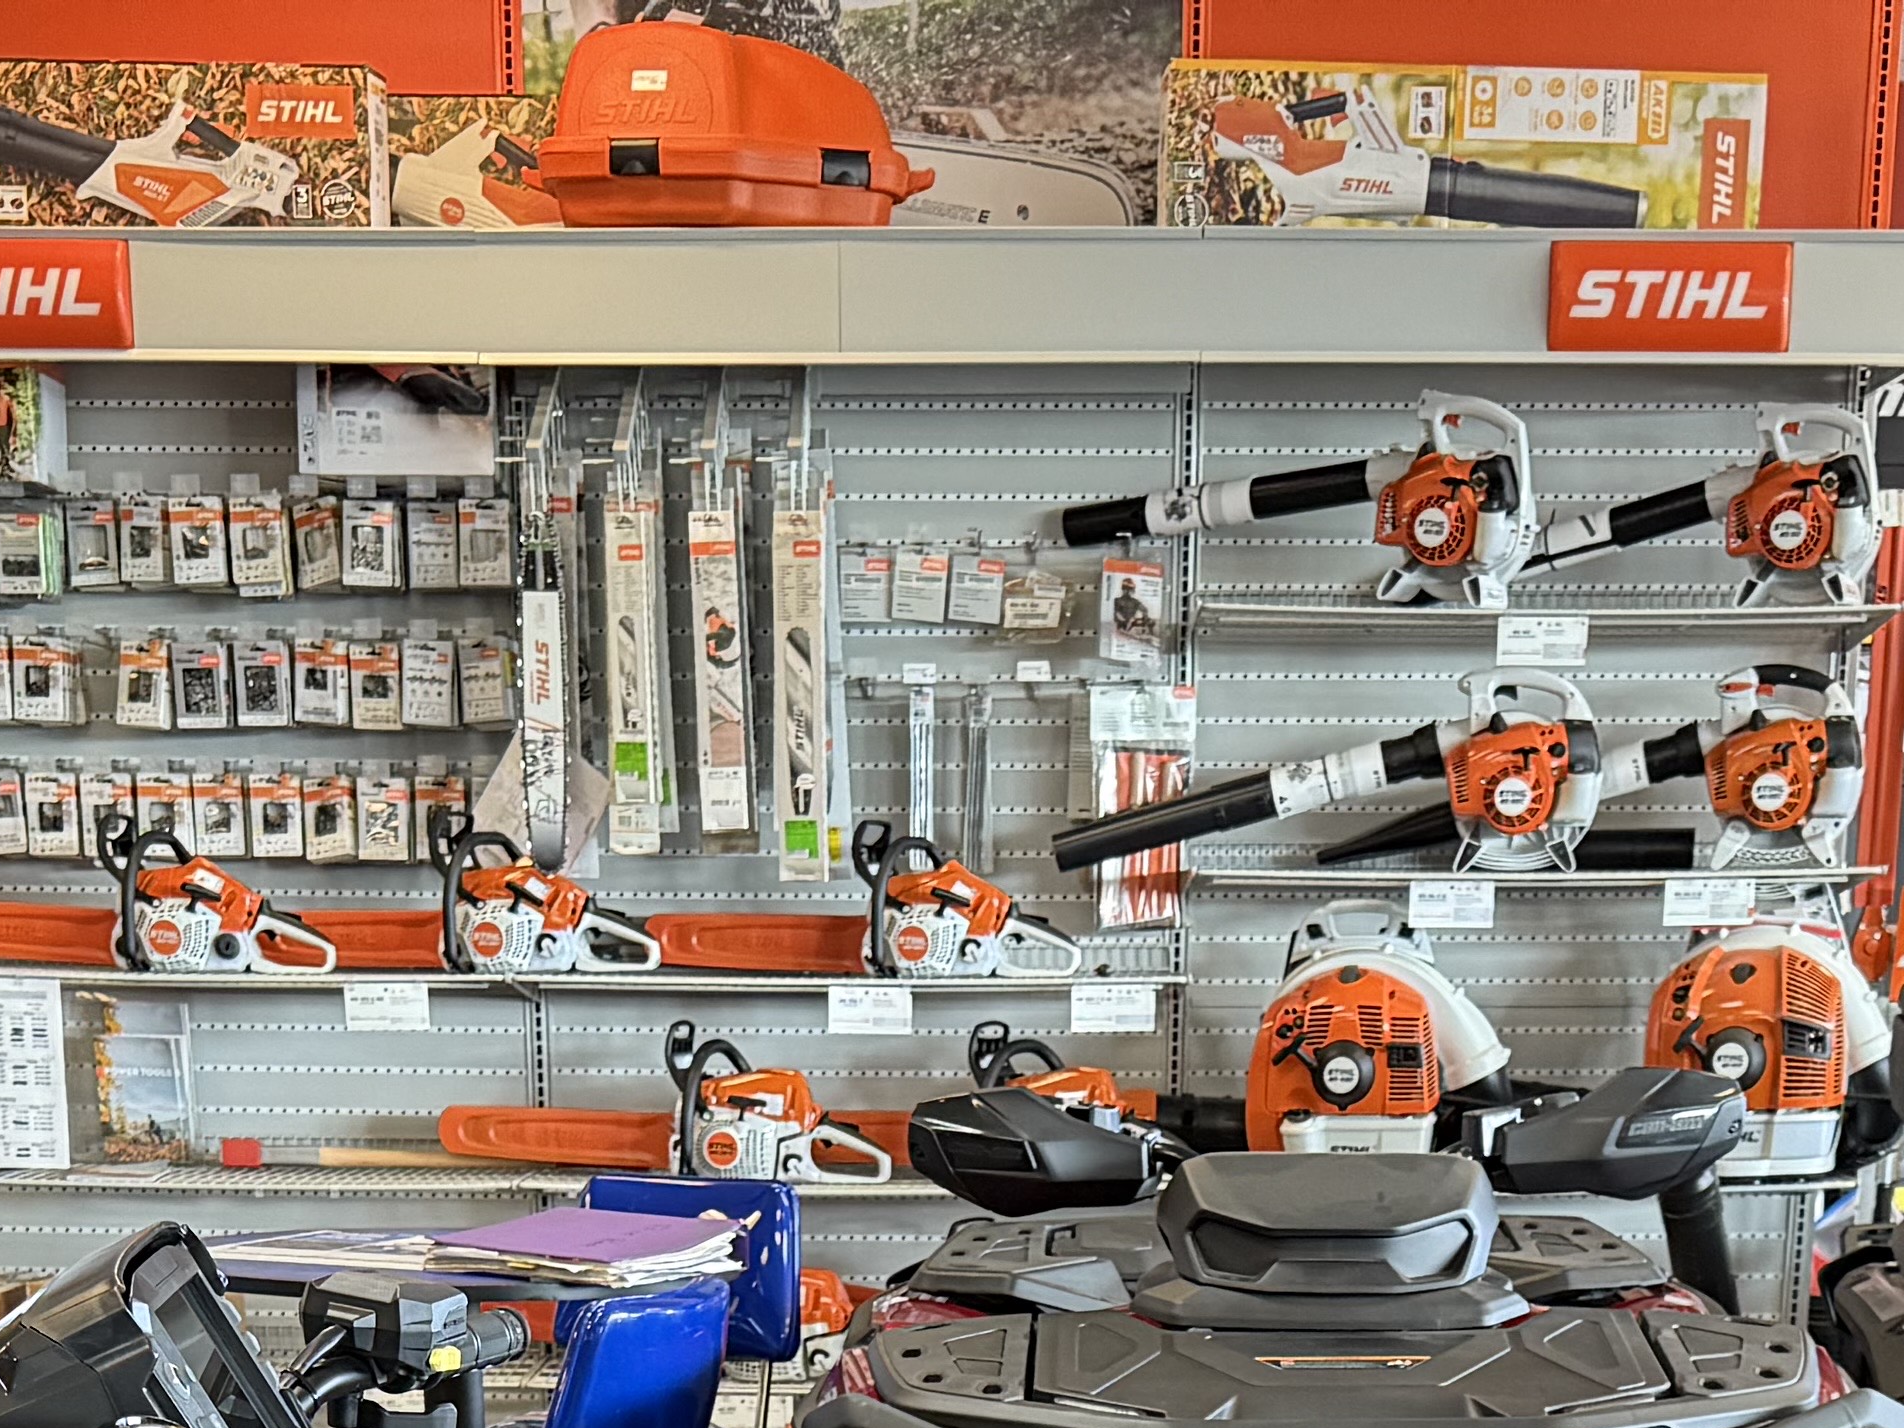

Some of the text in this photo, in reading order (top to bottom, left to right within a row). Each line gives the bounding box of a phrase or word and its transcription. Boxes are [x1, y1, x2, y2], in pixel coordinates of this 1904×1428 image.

[256, 100, 343, 124] STIHL
[590, 98, 696, 126] STIHL
[1339, 178, 1393, 195] STIHL
[1711, 131, 1736, 224] STIHL
[1569, 270, 1769, 320] STIHL
[535, 639, 550, 705] STIHL
